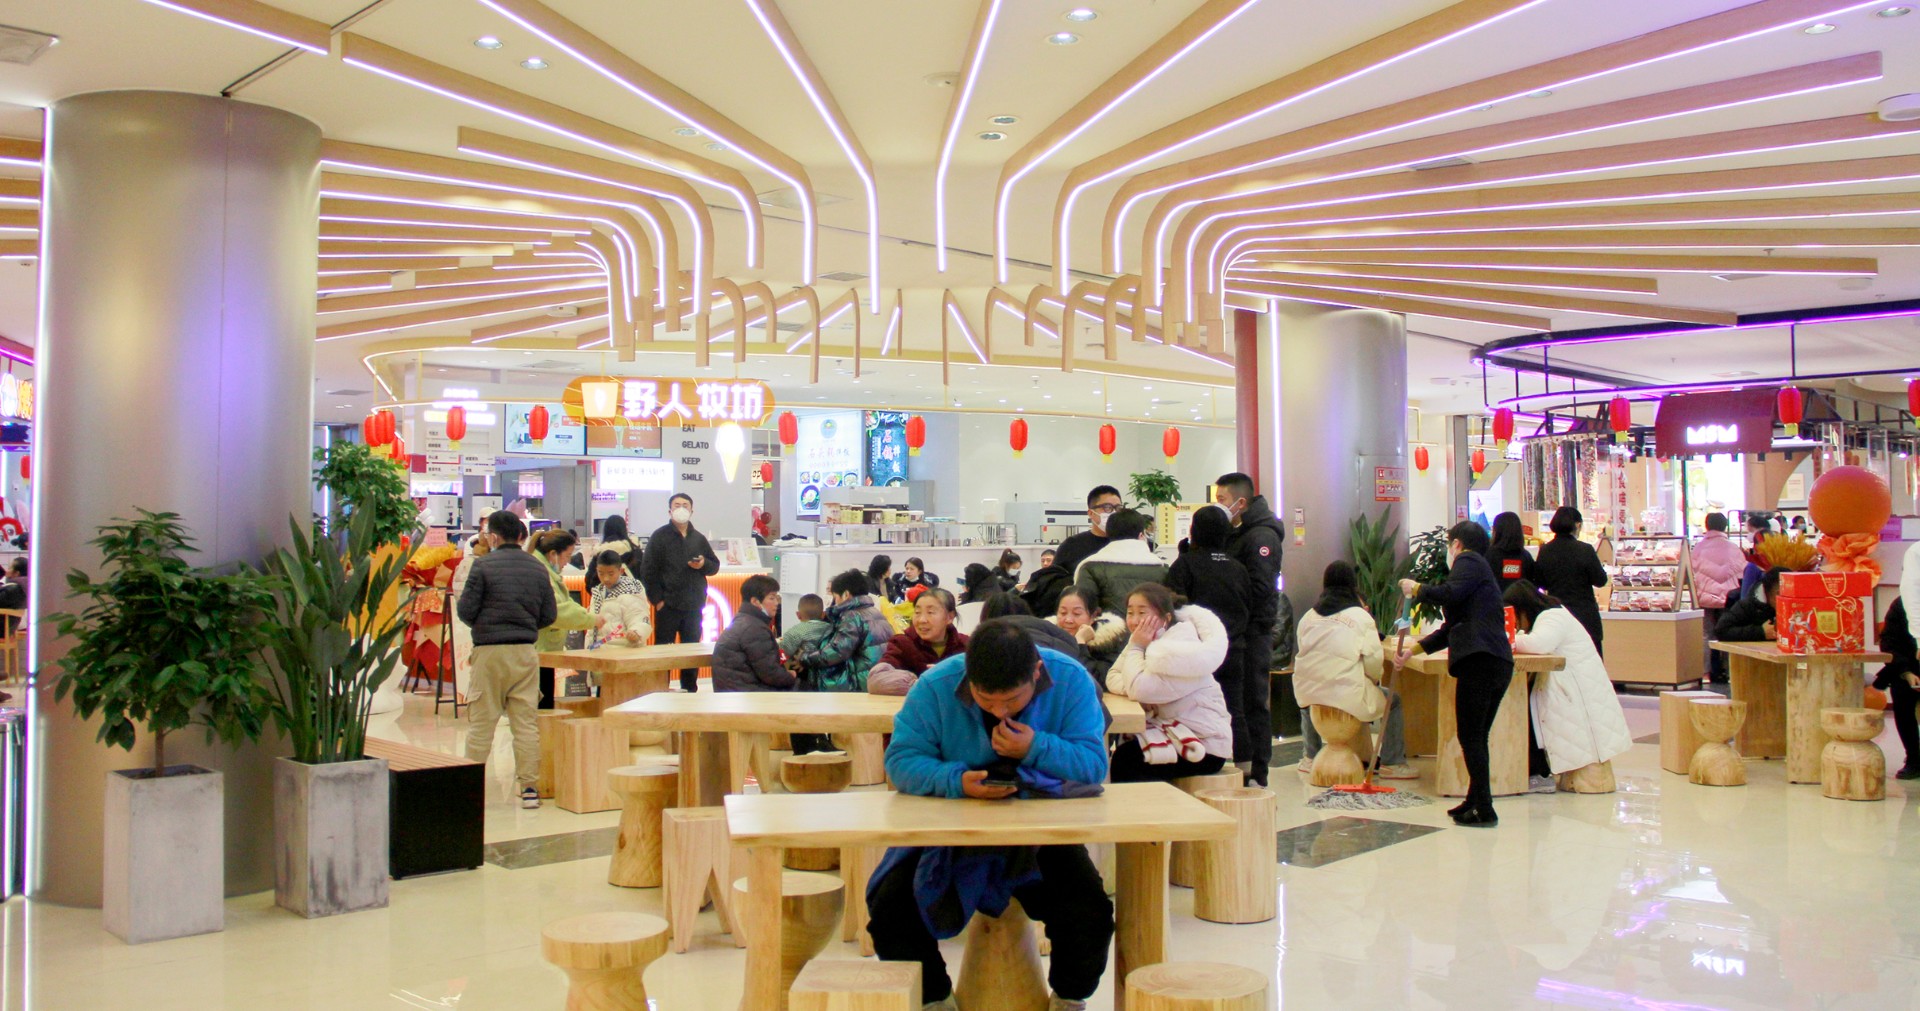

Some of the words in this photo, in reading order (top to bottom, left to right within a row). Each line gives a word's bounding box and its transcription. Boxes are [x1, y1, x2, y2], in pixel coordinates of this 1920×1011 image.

[623, 381, 765, 420] 野人牧坊
[682, 424, 696, 433] EAT
[681, 440, 710, 450] GELATO
[681, 457, 701, 466] KEEP
[681, 473, 704, 482] SMILE
